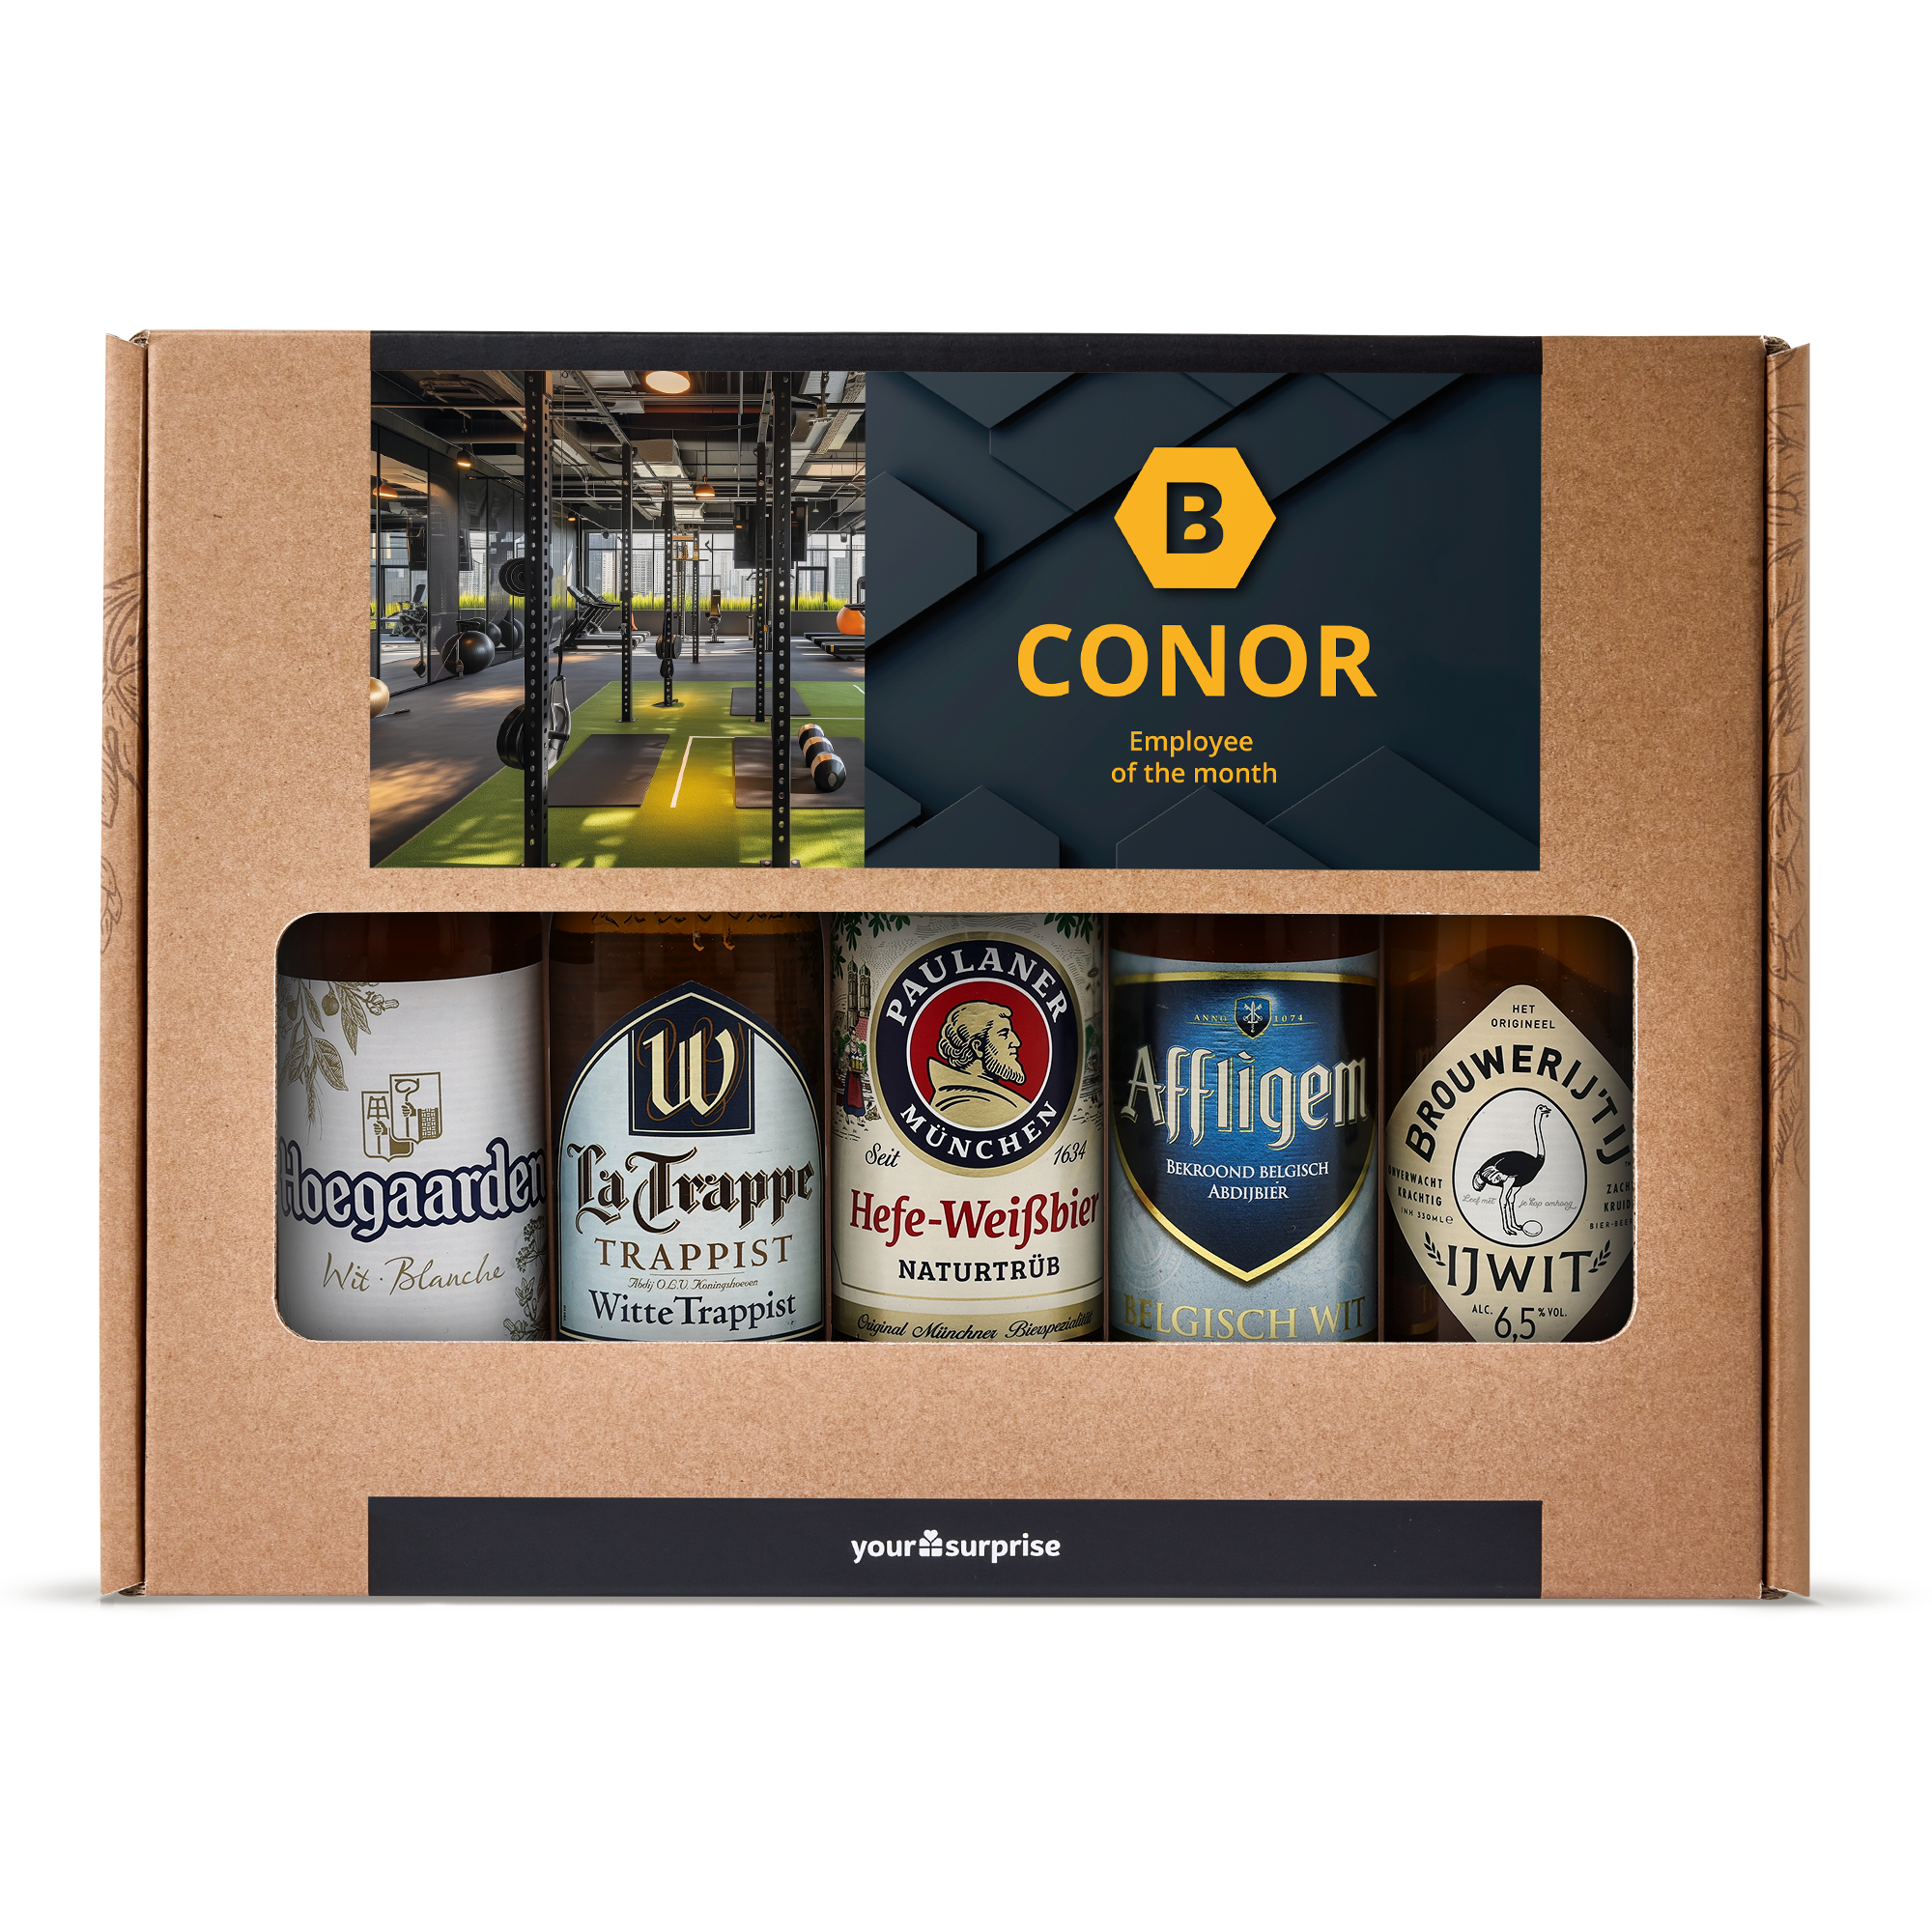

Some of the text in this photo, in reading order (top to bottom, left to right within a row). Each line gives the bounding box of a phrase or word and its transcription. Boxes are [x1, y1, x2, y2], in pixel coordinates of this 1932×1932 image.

[1166, 481, 1224, 554] B
[1017, 623, 1378, 697] CONOR
[1129, 730, 1254, 757] Employee
[1111, 761, 1277, 783] of the month
[887, 947, 1068, 1027] PAULANER
[1491, 1018, 1555, 1030] ORIGINEEL
[1513, 1005, 1536, 1014] HET
[1121, 1042, 1369, 1151] Affligem
[900, 1101, 1058, 1160] MÜNCHEN
[865, 1140, 1088, 1168] Seit 1634
[1166, 1158, 1329, 1179] BEKROOND BELGISCH
[278, 1136, 549, 1243] Hoegaarden
[567, 1143, 815, 1235] La Trappe
[1387, 1164, 1443, 1189] ONVERWACHT
[1208, 1184, 1290, 1204] ABDIJBIER
[1397, 1186, 1442, 1207] KRACHTIG
[849, 1187, 1100, 1250] Hefe-Weißbier
[1401, 1207, 1413, 1216] INH
[594, 1235, 793, 1271] TRAPPIST
[898, 1253, 1061, 1282] NATURTRÜB
[323, 1252, 506, 1295] Wit Blanche
[691, 1277, 758, 1293] Koningshoeven
[1447, 1244, 1593, 1295] IJWIT
[857, 1310, 1094, 1341] Original Münchner Bierspezialität
[1123, 1293, 1366, 1340] BELGISCH WIT
[1471, 1304, 1493, 1315] ALC.
[1494, 1306, 1536, 1343] 6,5
[851, 1532, 1061, 1564] your surprise
